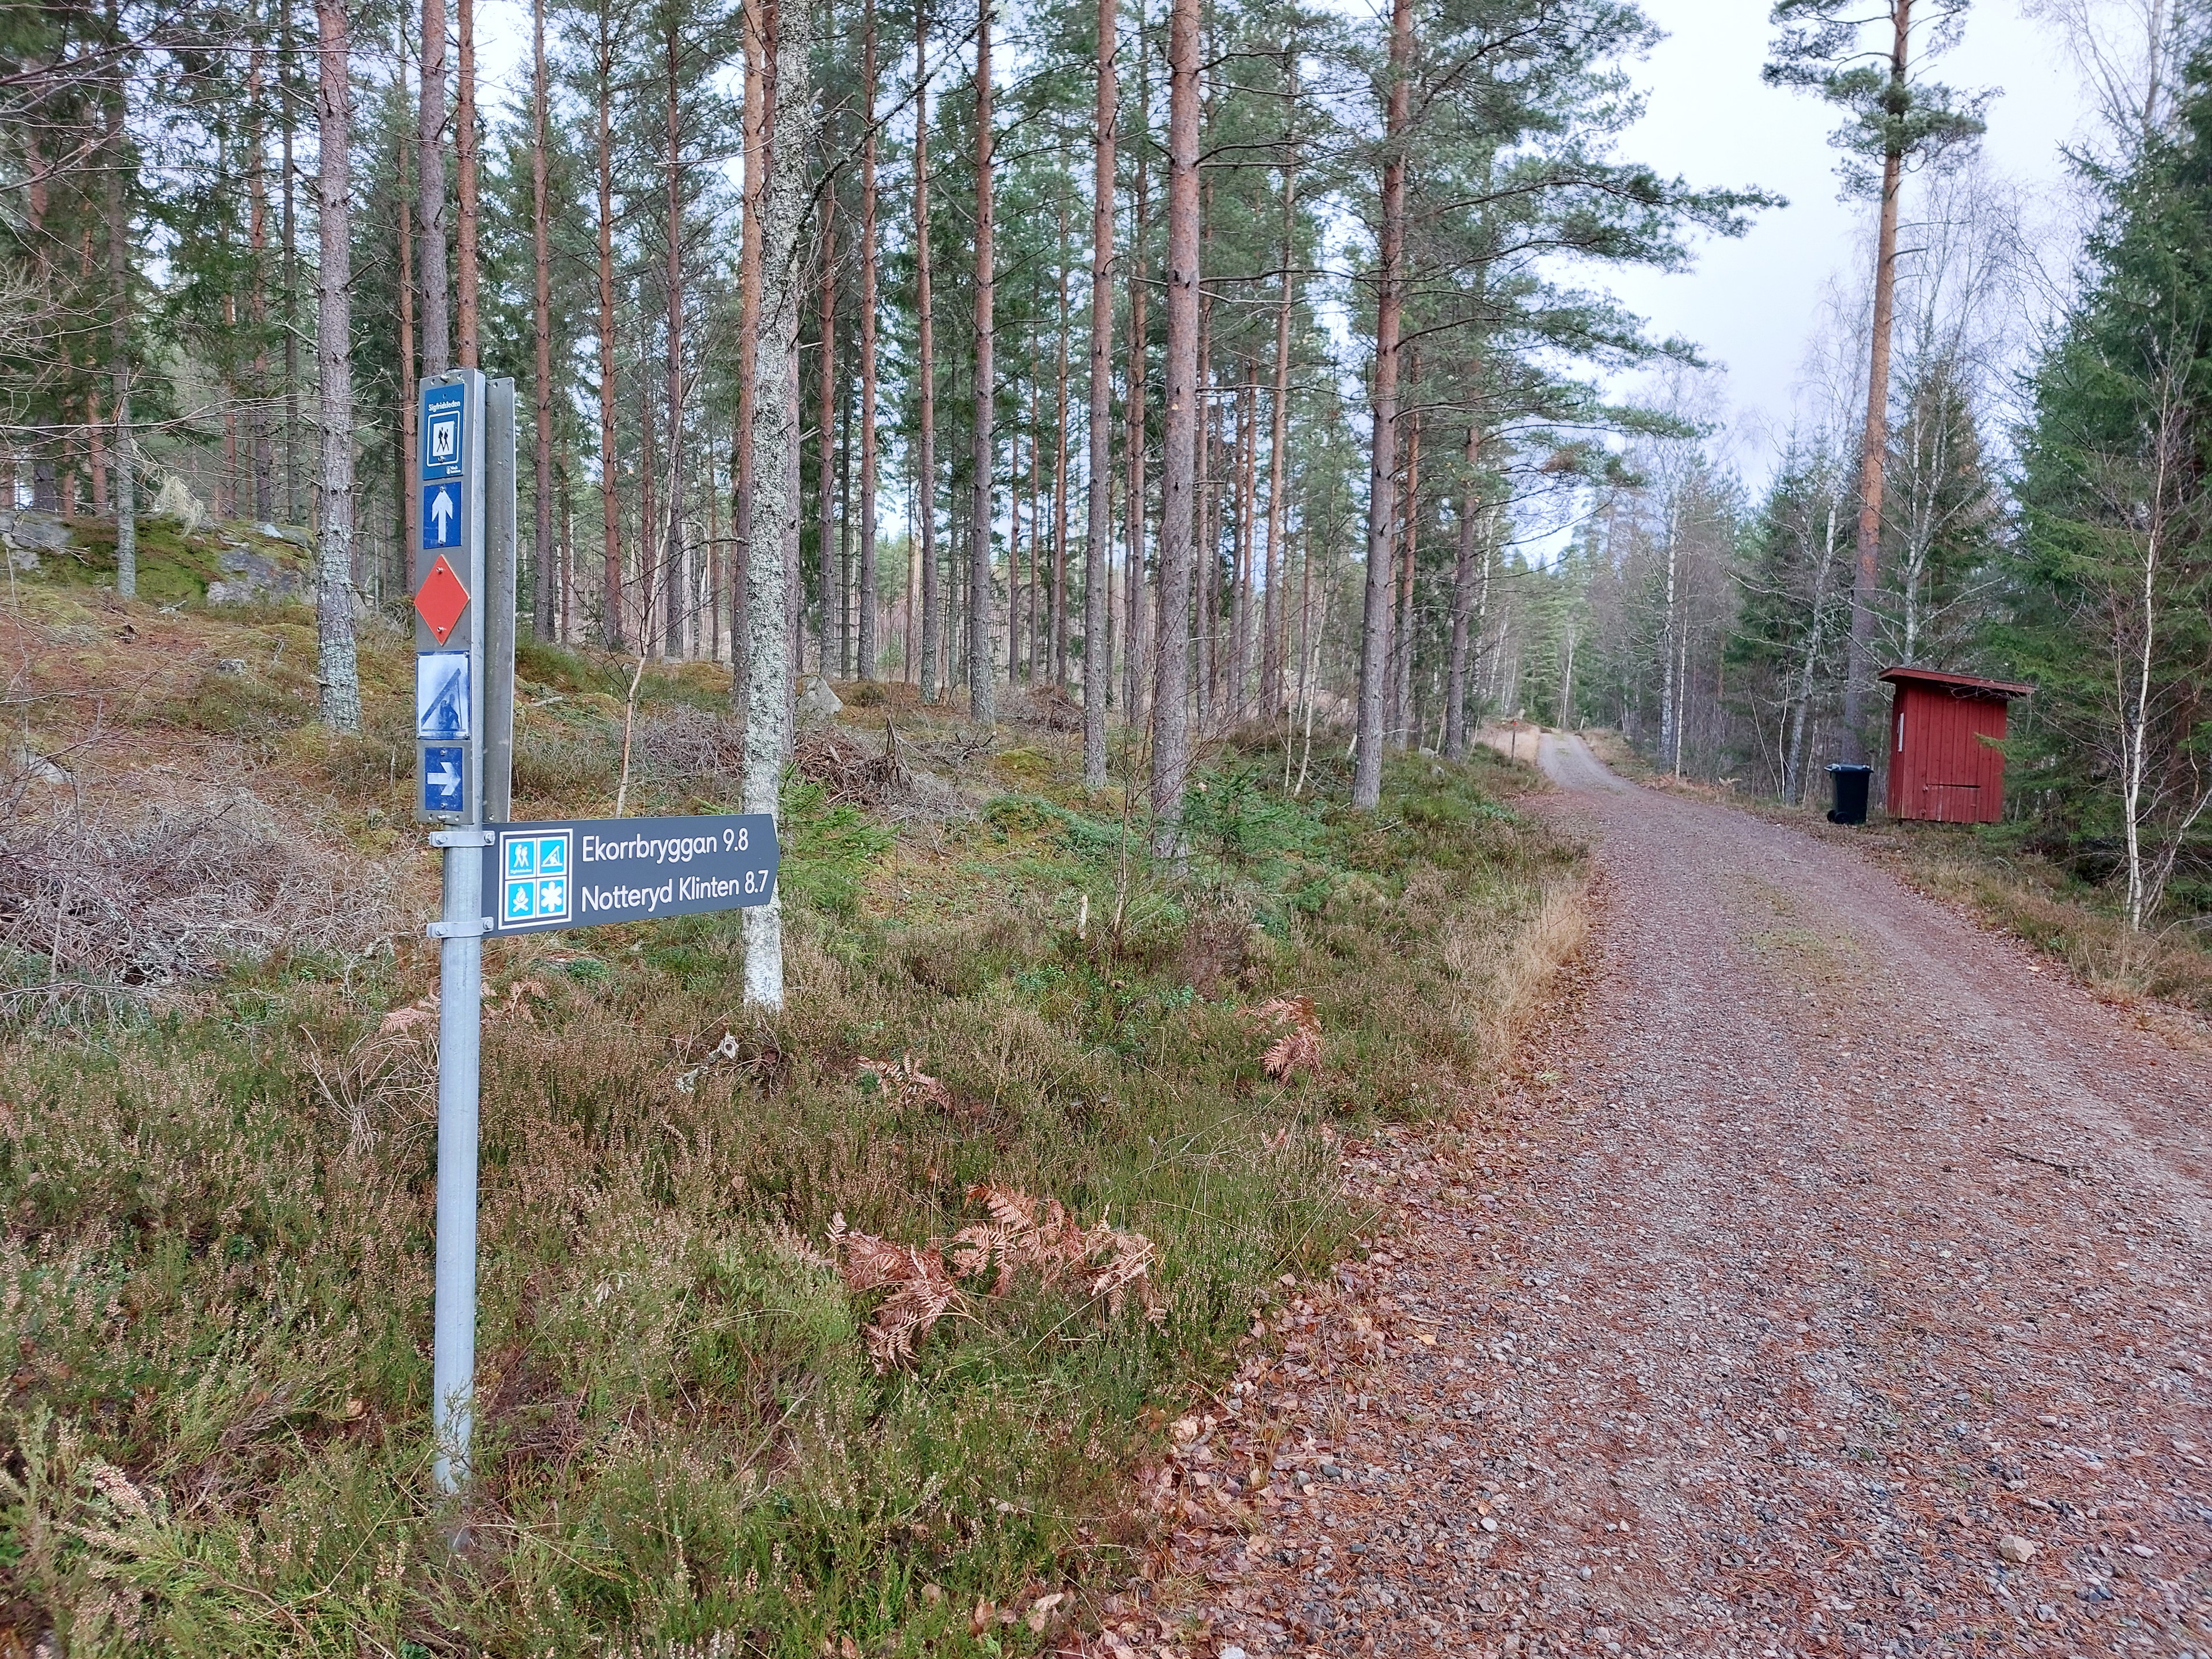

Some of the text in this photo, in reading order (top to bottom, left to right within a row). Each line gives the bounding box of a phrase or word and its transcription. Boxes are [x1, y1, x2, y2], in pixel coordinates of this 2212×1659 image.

[428, 400, 461, 412] Sigfridsleden
[582, 828, 749, 864] Ekorrbryggan 9.8
[581, 870, 770, 912] Notteryd Klinten 8.7
